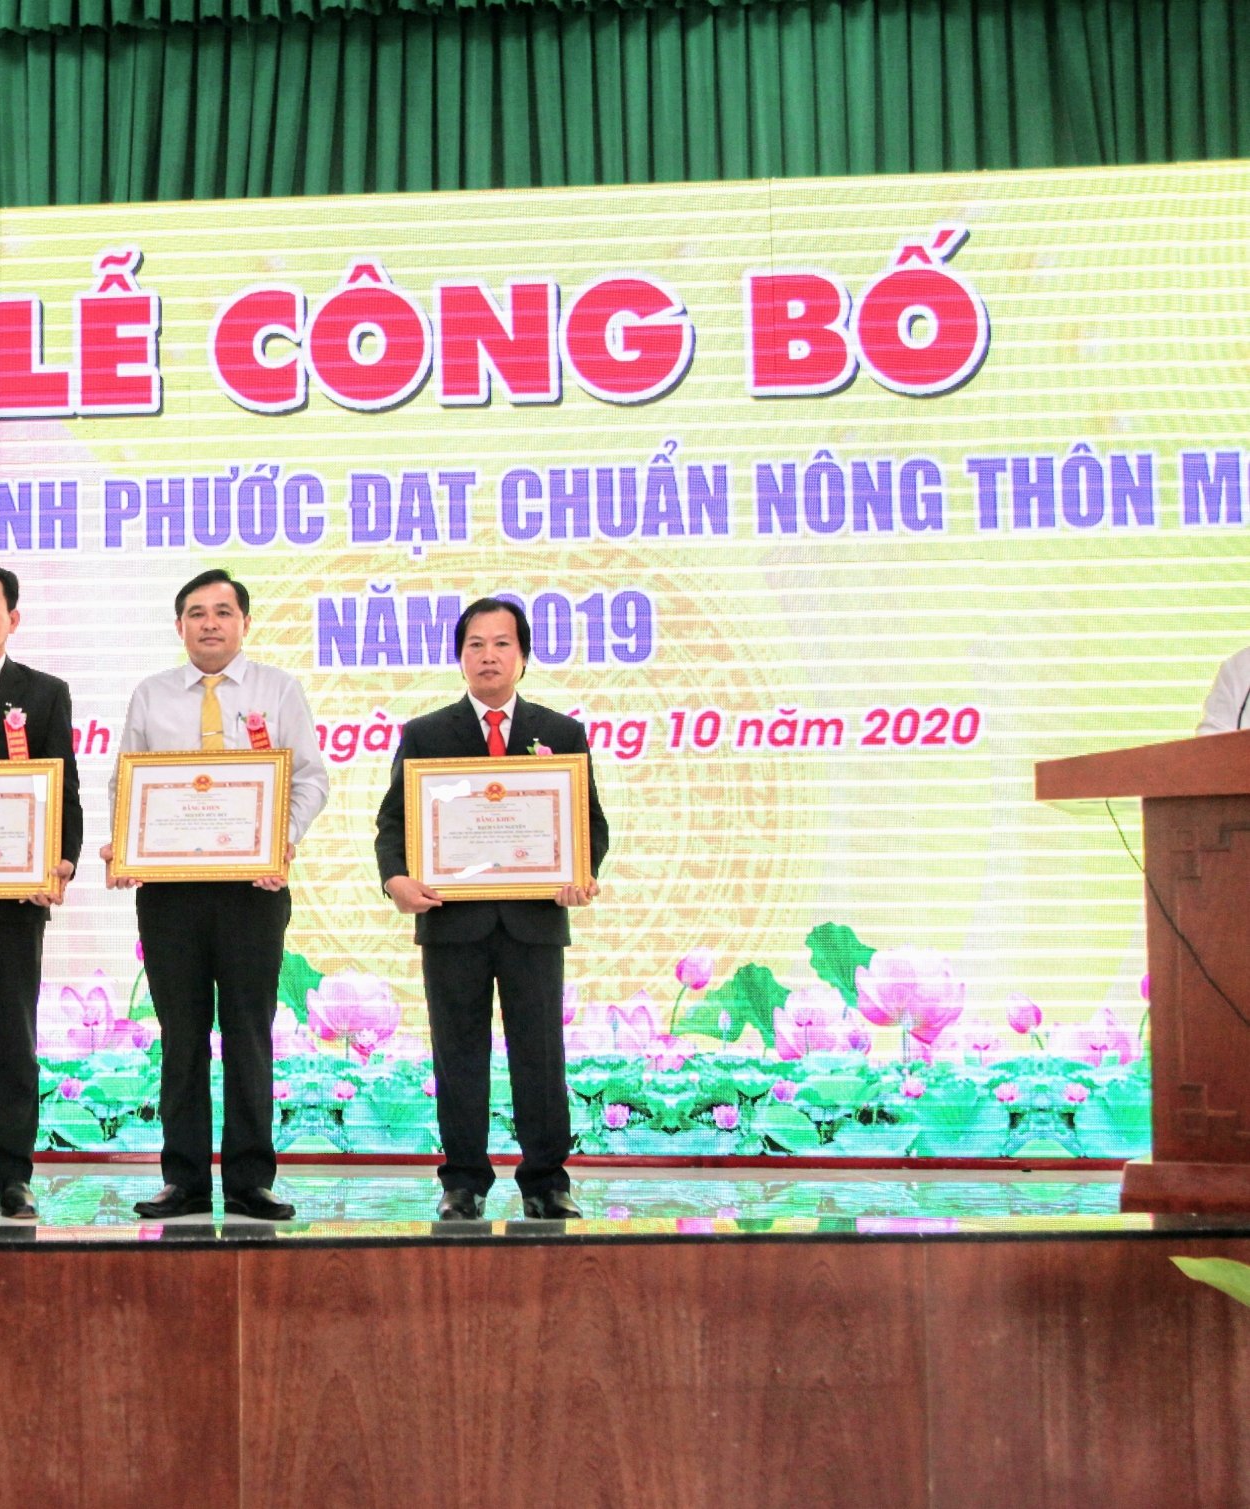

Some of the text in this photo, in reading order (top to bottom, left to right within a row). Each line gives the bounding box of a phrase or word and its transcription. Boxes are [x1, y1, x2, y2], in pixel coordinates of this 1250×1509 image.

[214, 263, 684, 404] CÔNG
[751, 228, 979, 388] BỐ
[104, 464, 325, 548] PHƯỚC
[349, 471, 476, 555] ĐẠT
[501, 440, 729, 540] CHUẨN
[756, 449, 943, 534] NÔNG
[967, 443, 1155, 529] THÔN
[1182, 451, 1250, 525] M
[318, 584, 461, 667] NĂM
[316, 712, 404, 763] ngà
[672, 711, 721, 748] 10
[738, 709, 844, 747] năm
[862, 707, 980, 745] 2020
